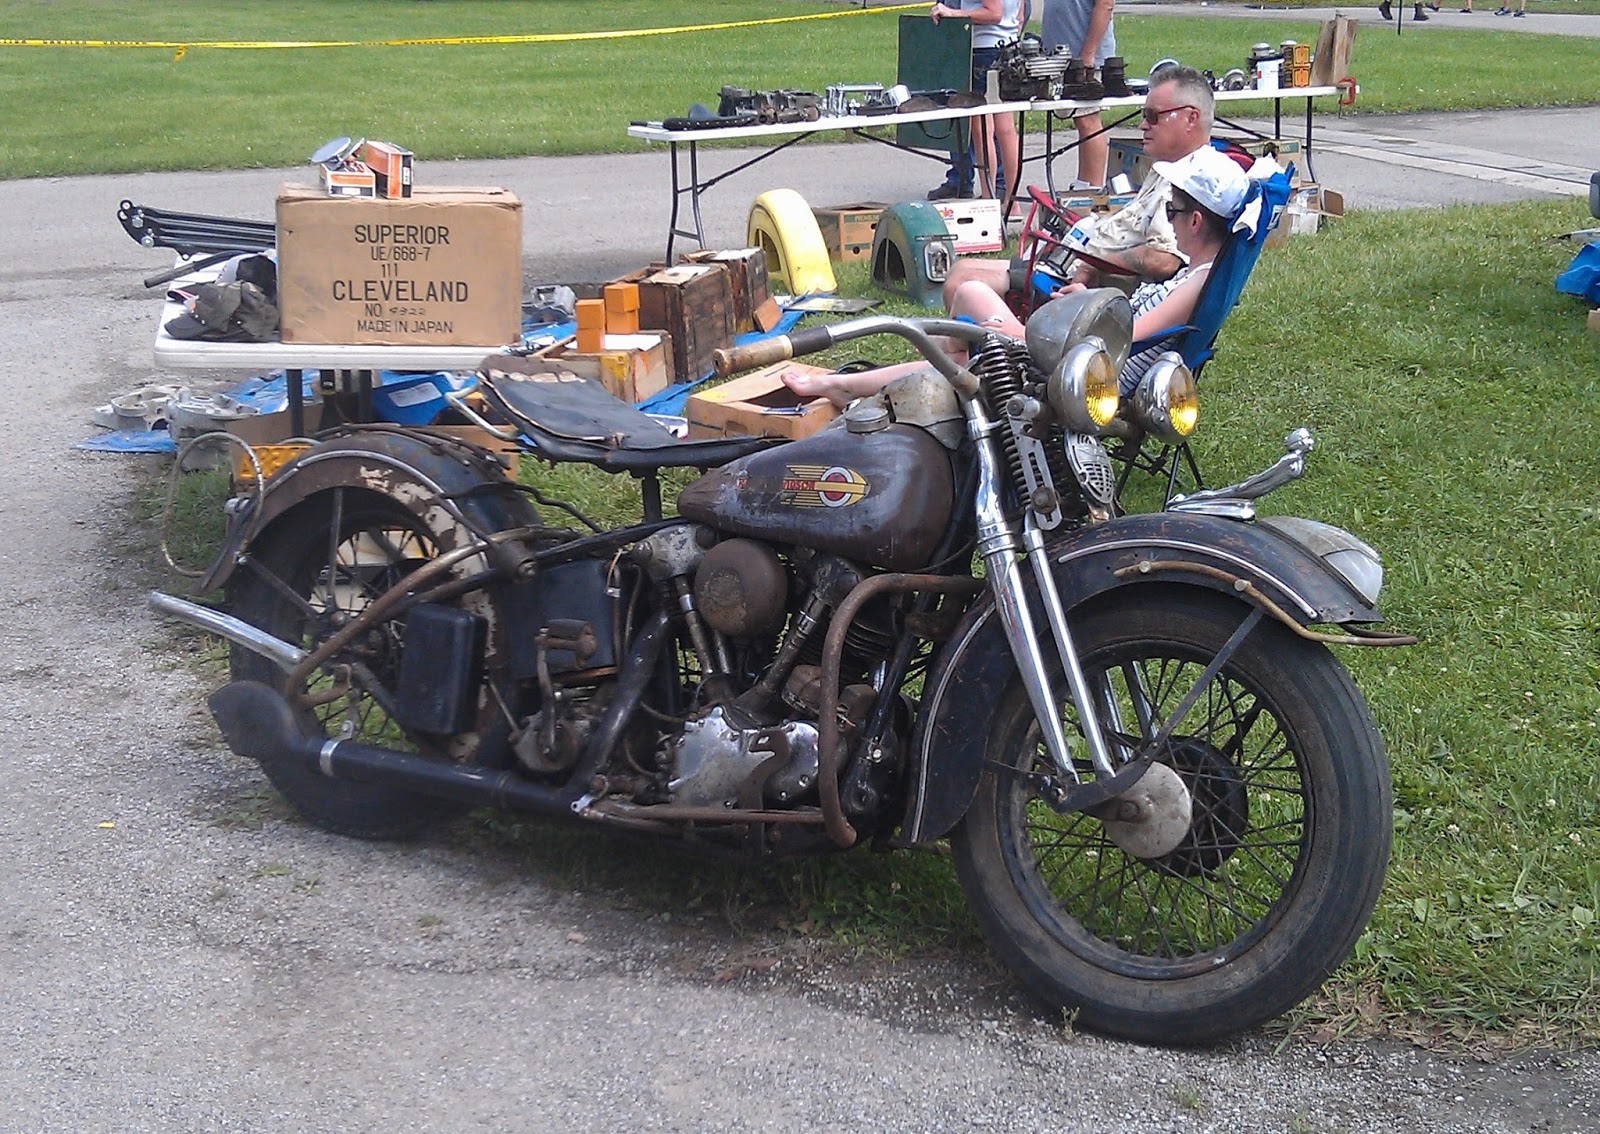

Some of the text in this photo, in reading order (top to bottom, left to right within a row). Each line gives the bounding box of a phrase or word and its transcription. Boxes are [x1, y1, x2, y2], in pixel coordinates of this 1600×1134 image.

[354, 224, 450, 245] SUPERIOR
[370, 246, 431, 261] UE/668-7
[332, 280, 469, 302] CLEVELAND
[357, 320, 453, 334] MADE IN JAPAN
